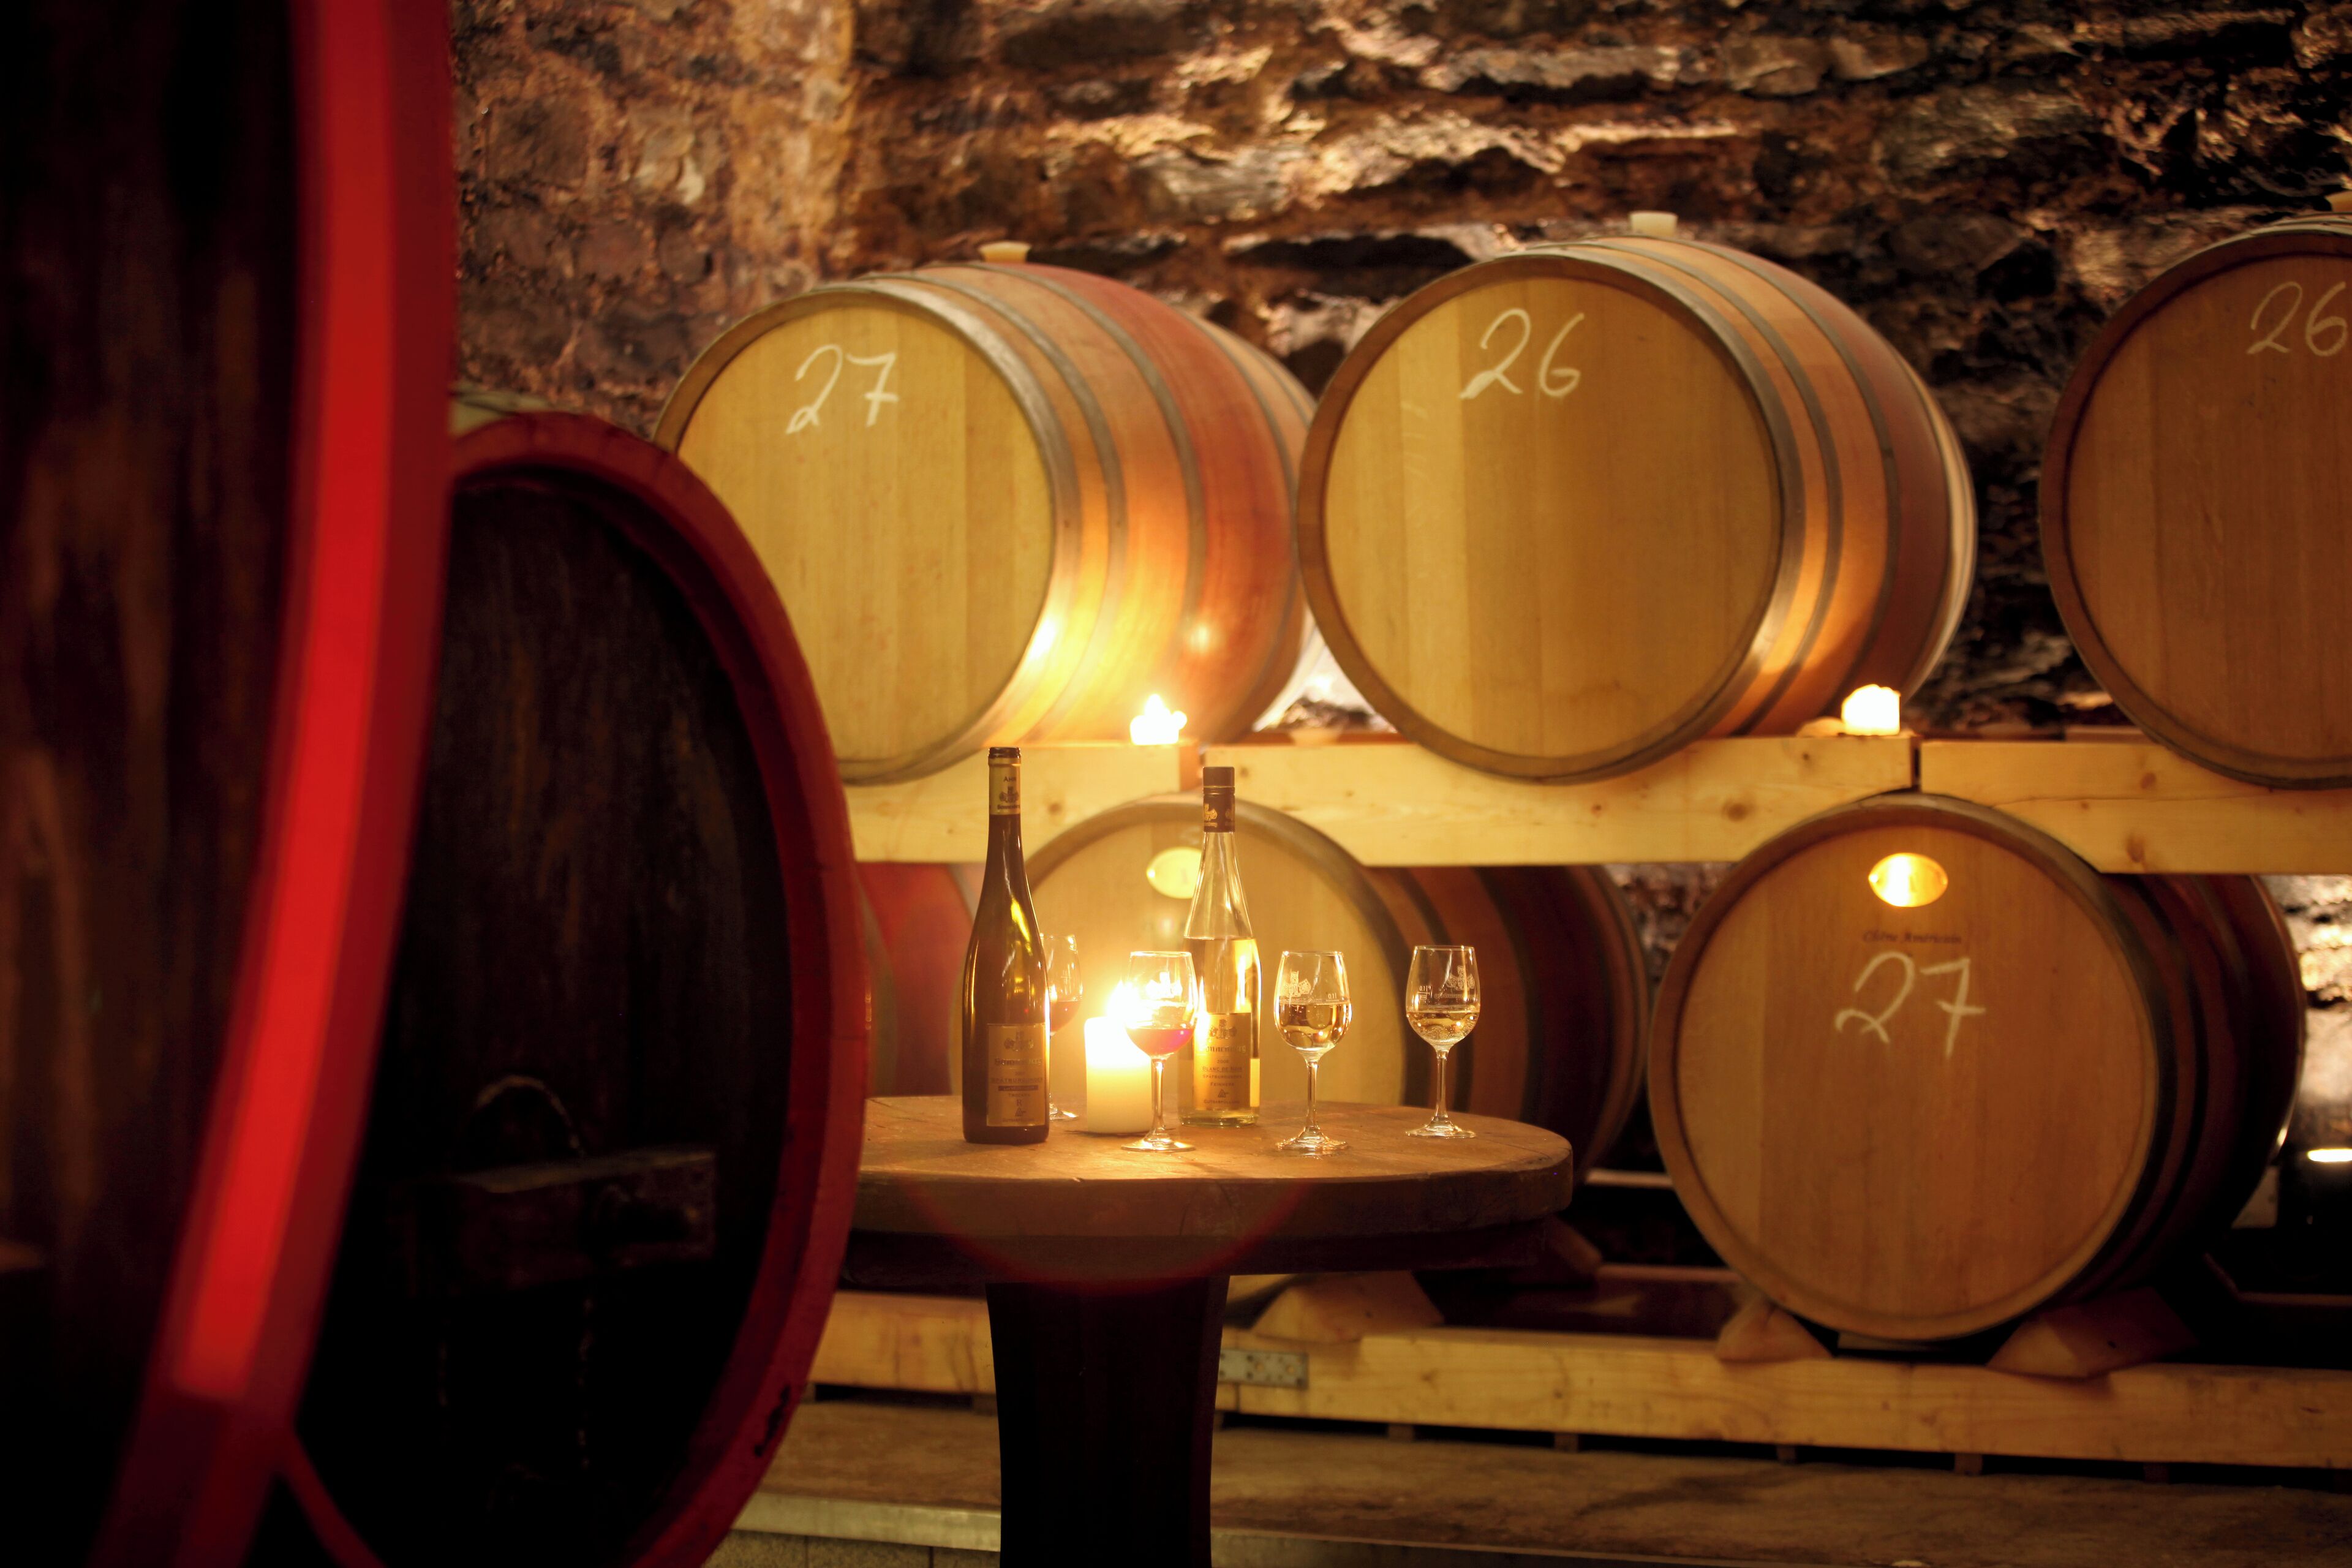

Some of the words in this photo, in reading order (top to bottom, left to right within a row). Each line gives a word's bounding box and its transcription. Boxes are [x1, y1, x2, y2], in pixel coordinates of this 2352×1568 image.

[1459, 308, 1585, 399] 26
[2246, 281, 2347, 356] 26
[785, 344, 899, 434] 27
[1834, 951, 1986, 1059] 27
